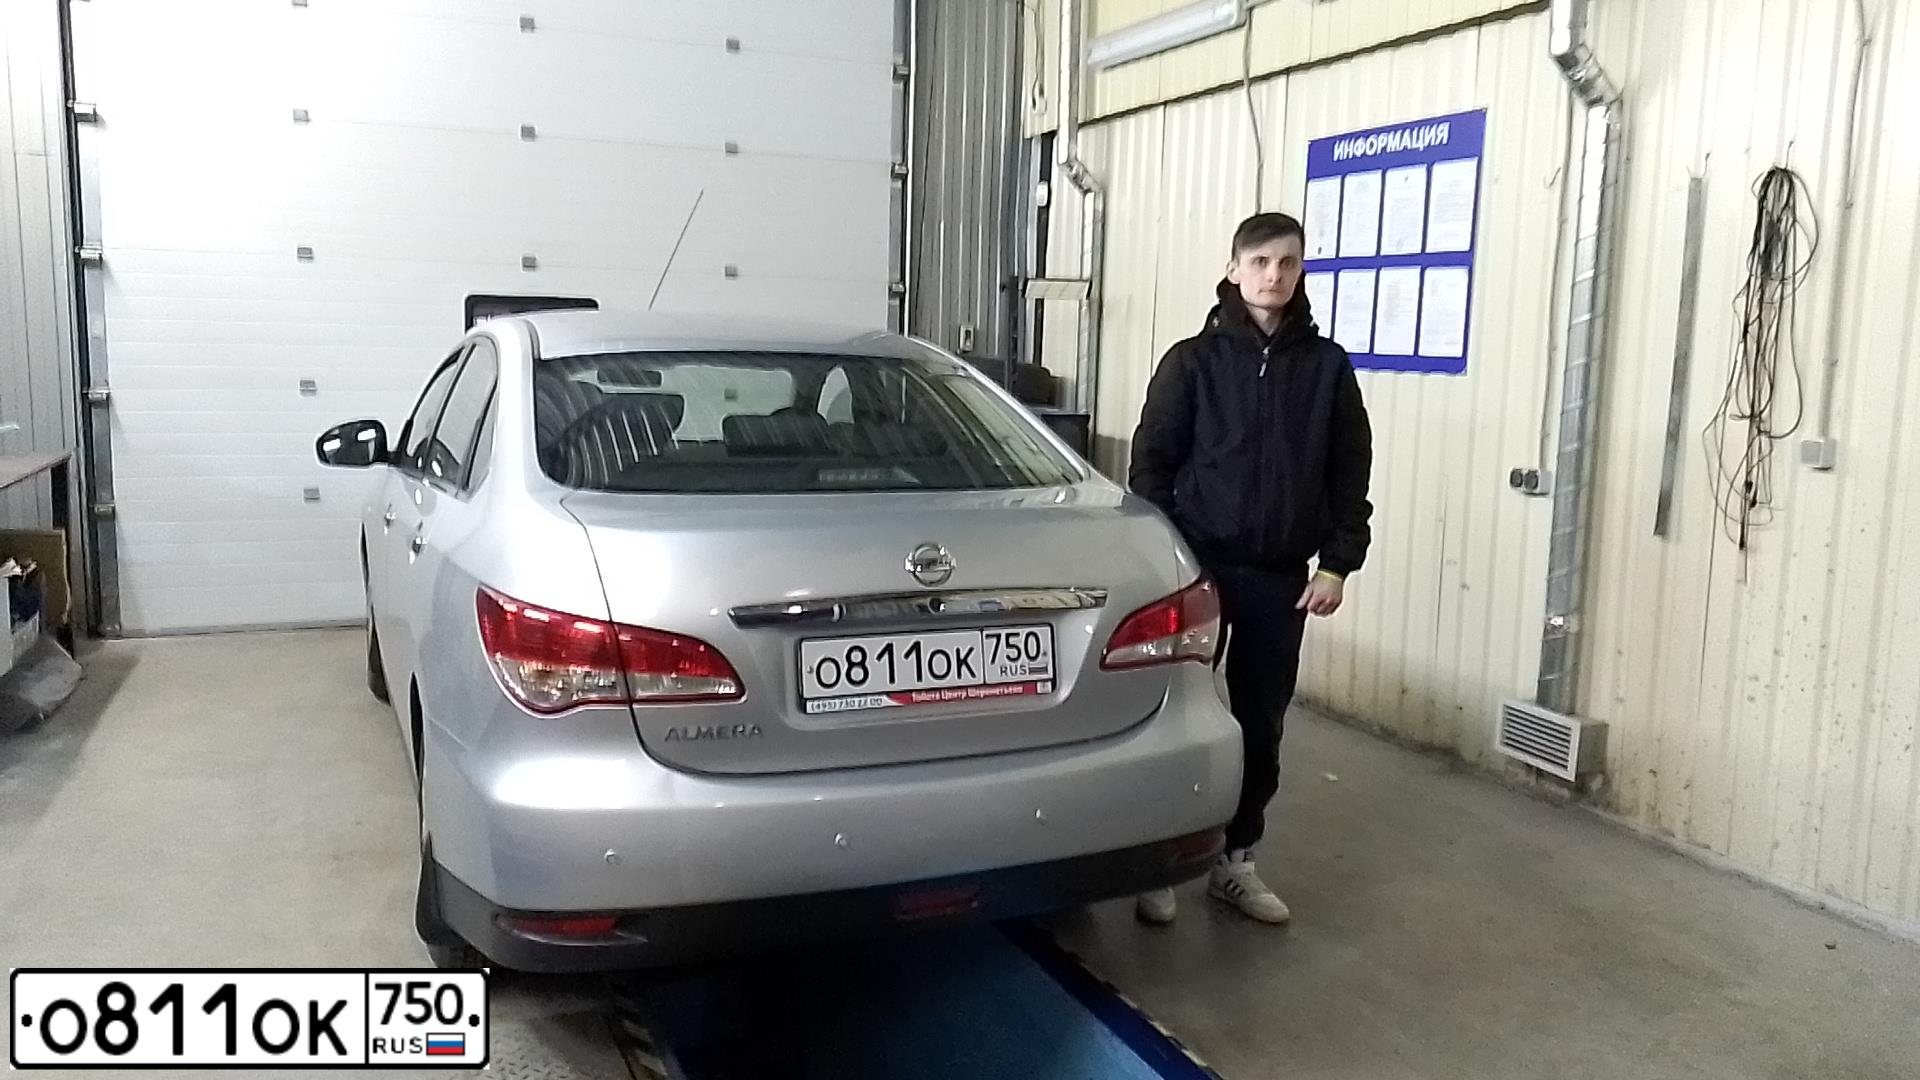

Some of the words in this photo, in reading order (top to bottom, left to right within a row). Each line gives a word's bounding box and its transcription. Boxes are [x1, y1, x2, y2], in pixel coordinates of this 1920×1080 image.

[1333, 121, 1450, 161] ИНФОРМАЦИЯ
[984, 631, 1041, 665] 750
[1000, 665, 1027, 677] RUS
[664, 724, 764, 742] ALMERA
